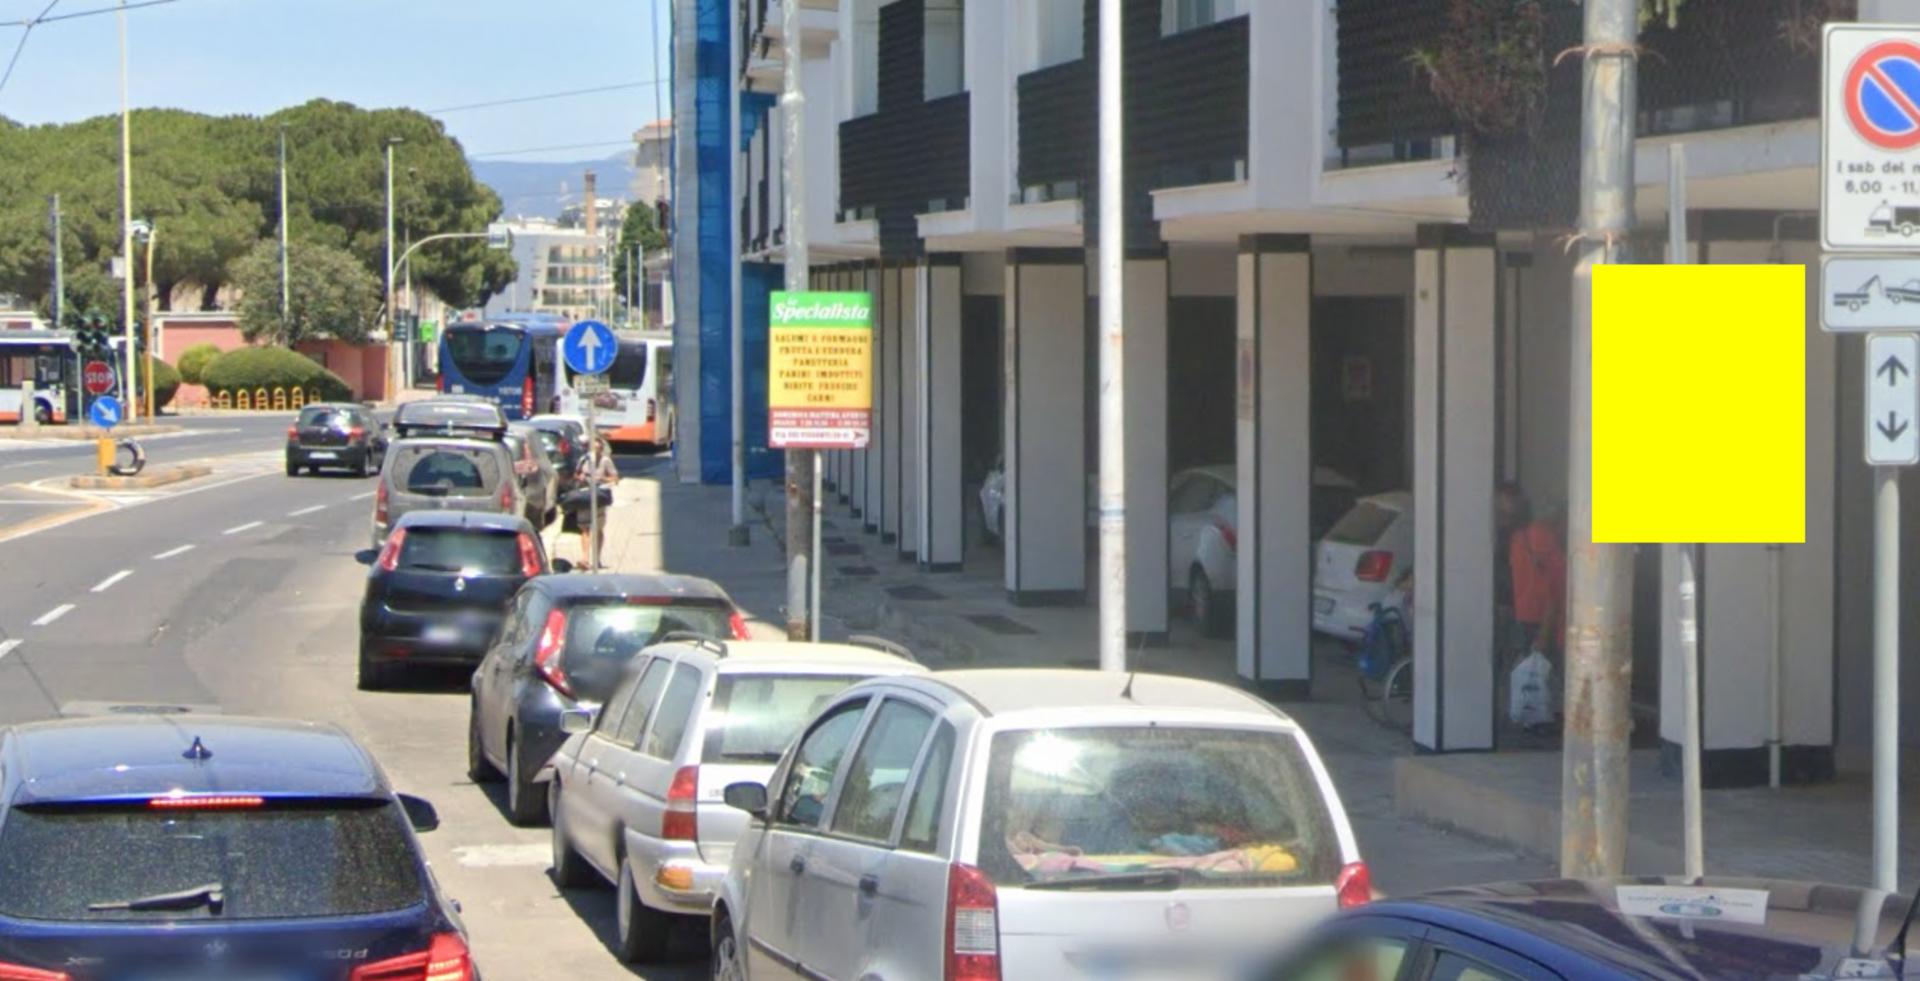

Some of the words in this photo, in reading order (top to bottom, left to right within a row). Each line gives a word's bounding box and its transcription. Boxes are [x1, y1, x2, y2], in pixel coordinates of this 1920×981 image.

[1848, 161, 1874, 173] sab
[1881, 160, 1904, 173] del
[775, 303, 870, 322] Specialista
[86, 372, 112, 384] STOP
